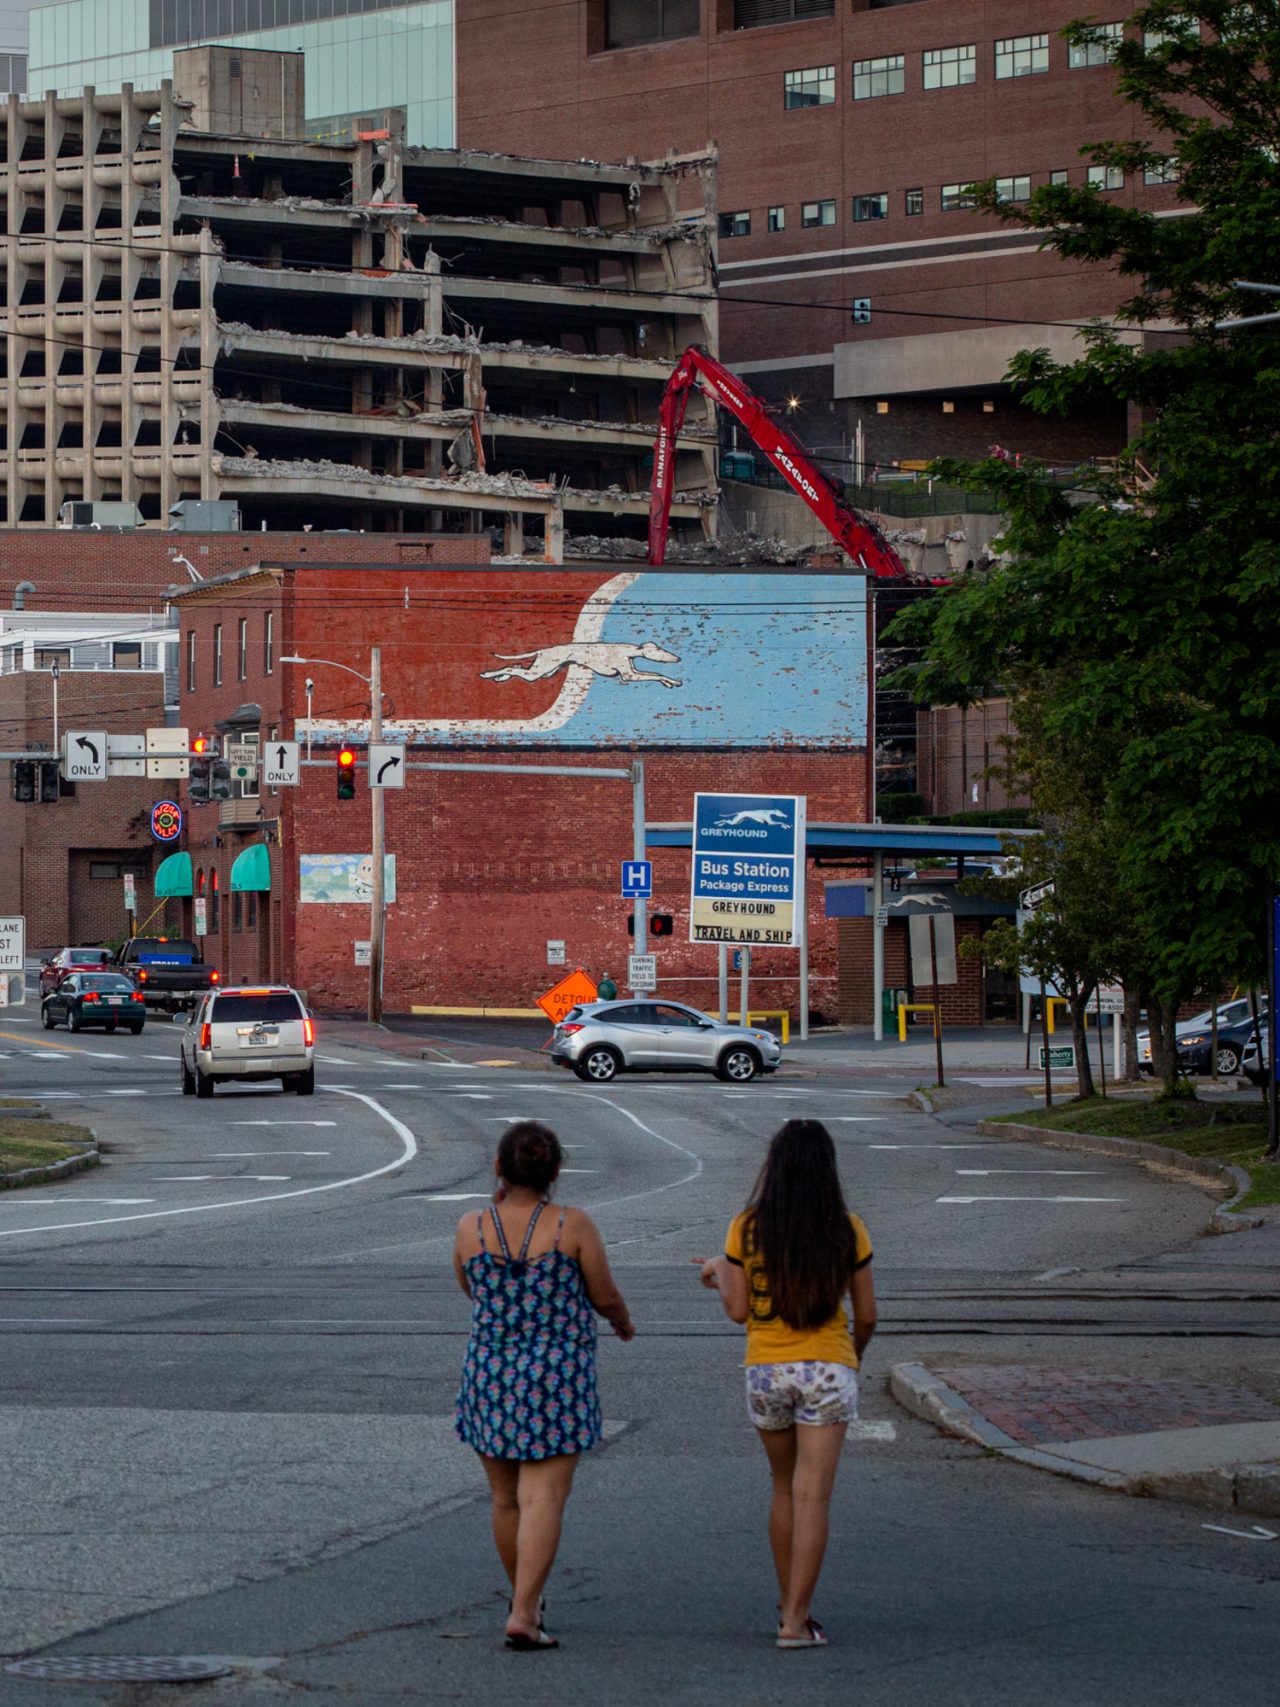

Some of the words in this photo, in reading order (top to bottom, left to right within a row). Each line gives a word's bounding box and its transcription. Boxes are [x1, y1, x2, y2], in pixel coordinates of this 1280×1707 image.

[657, 426, 667, 488] MANAFORT
[71, 766, 102, 776] ONLY
[268, 771, 295, 782] ONLY
[154, 803, 180, 819] PIZZA
[153, 822, 179, 838] VILLA
[700, 827, 768, 839] GREYHOUND
[628, 865, 646, 887] H
[701, 860, 729, 876] Bus
[733, 861, 790, 878] Station
[700, 879, 745, 892] Package
[747, 881, 789, 893] Express
[893, 878, 899, 890] 2
[712, 901, 776, 915] GREYHOUND
[696, 926, 735, 940] TRAVEL
[739, 930, 760, 940] AND
[765, 930, 792, 941] SHIP
[0, 955, 20, 964] LEFT
